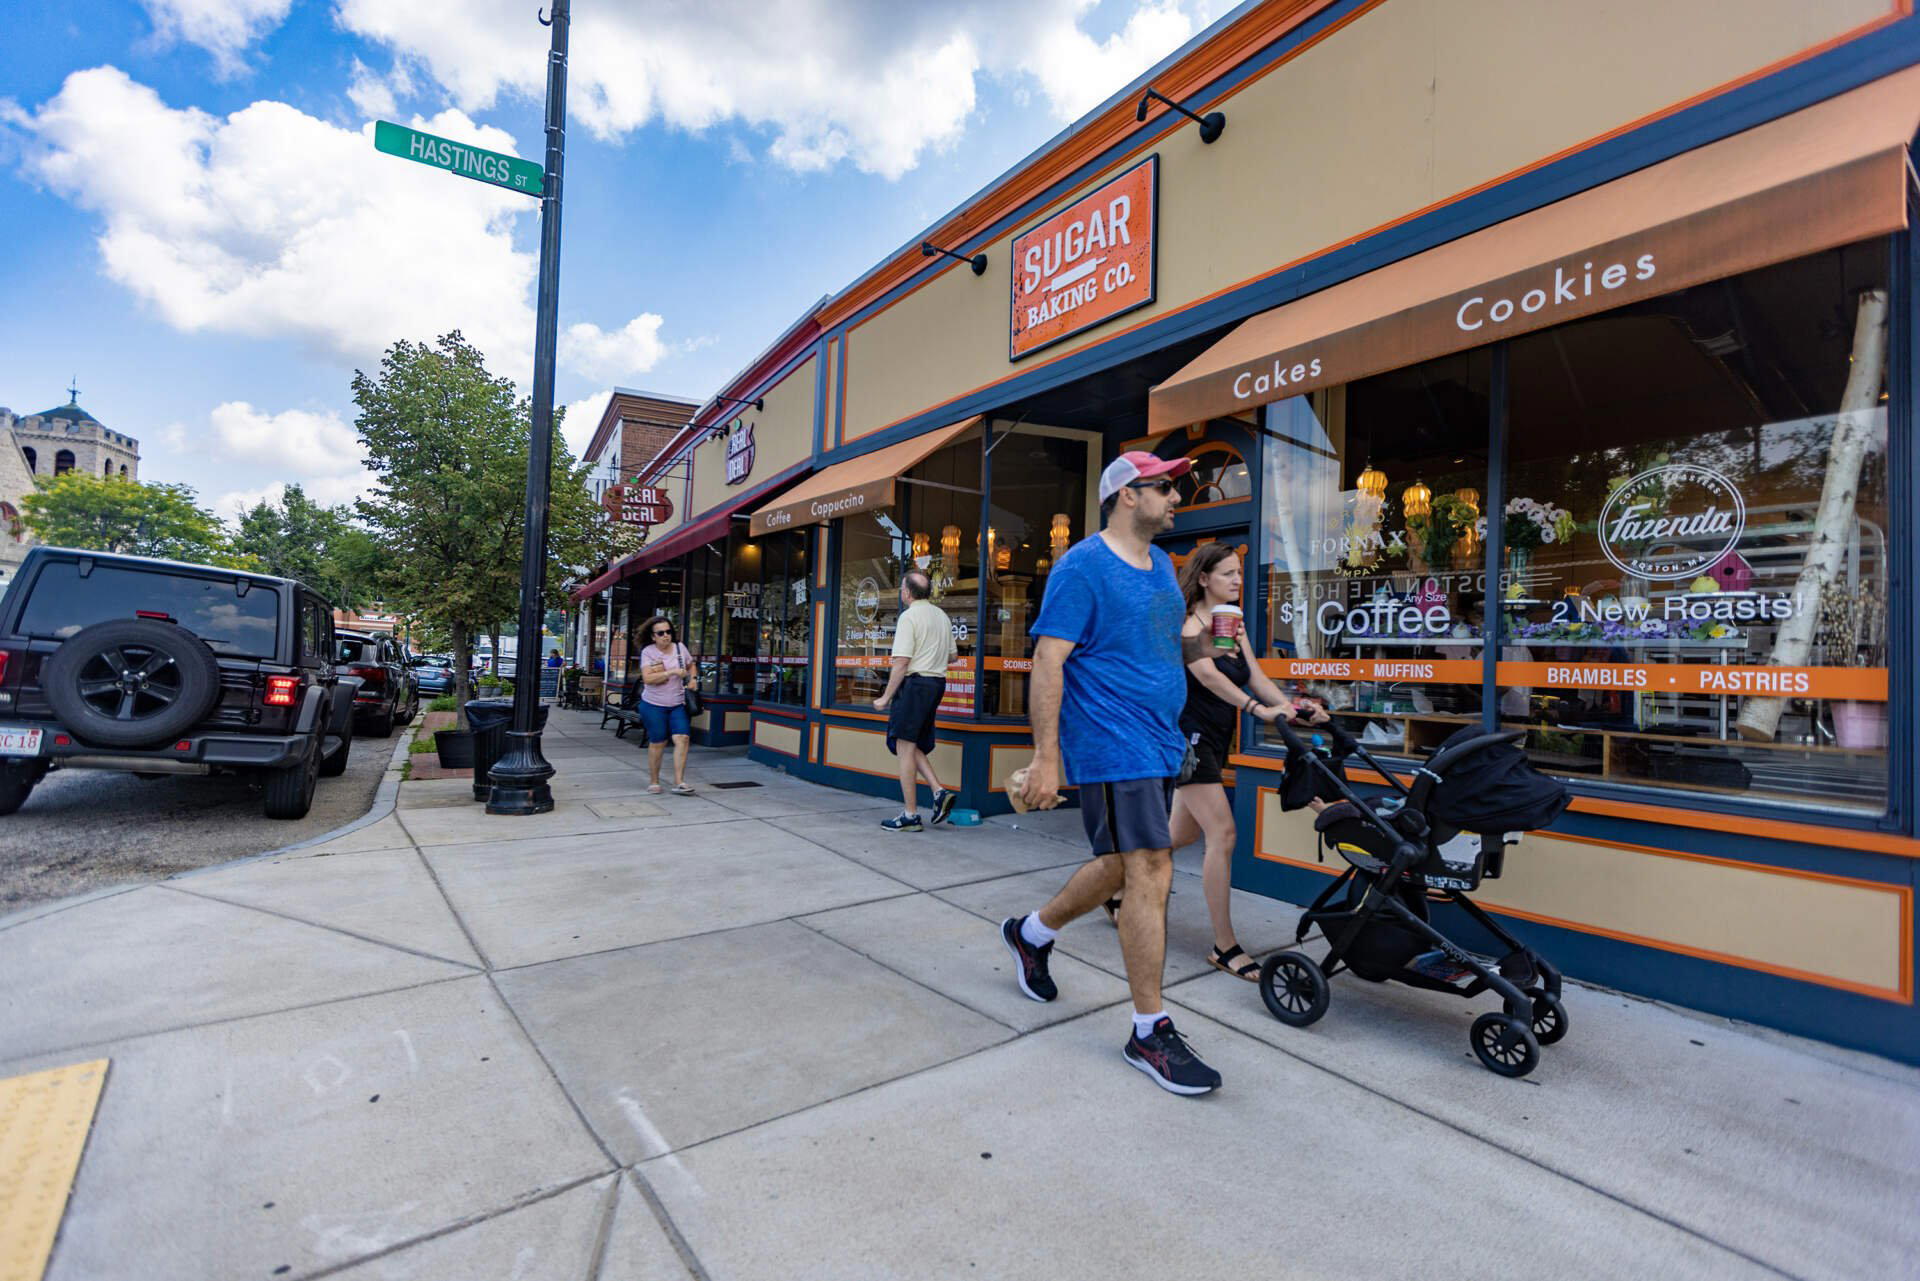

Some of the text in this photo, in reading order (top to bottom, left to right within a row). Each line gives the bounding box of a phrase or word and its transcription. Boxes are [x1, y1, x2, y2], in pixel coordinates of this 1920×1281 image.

[410, 134, 528, 187] HASTINGS ST
[1024, 195, 1131, 294] SUGAR
[1027, 262, 1136, 329] BAKING CO.
[1456, 252, 1656, 332] Cookies
[1233, 355, 1322, 400] Cakes
[731, 428, 747, 455] REAL
[729, 455, 745, 481] DEAL
[623, 486, 660, 504] REAL
[1619, 473, 1722, 505] COFFEE ROASTERS
[622, 505, 658, 522] DEAL
[766, 493, 864, 527] Coffee Cappuccino
[1609, 503, 1733, 543] Fazenda
[1311, 530, 1407, 554] FORNAX
[1331, 555, 1386, 577] OMPANY
[1404, 592, 1448, 603] Any Size
[1551, 592, 1803, 623] 2 New Roasts!
[1280, 599, 1450, 635] $1 Coffee
[1003, 659, 1033, 670] SCONES
[1290, 662, 1434, 678] CUPCAKES MUFFINS
[1547, 667, 1809, 692] BRAMBLES PASTRIES
